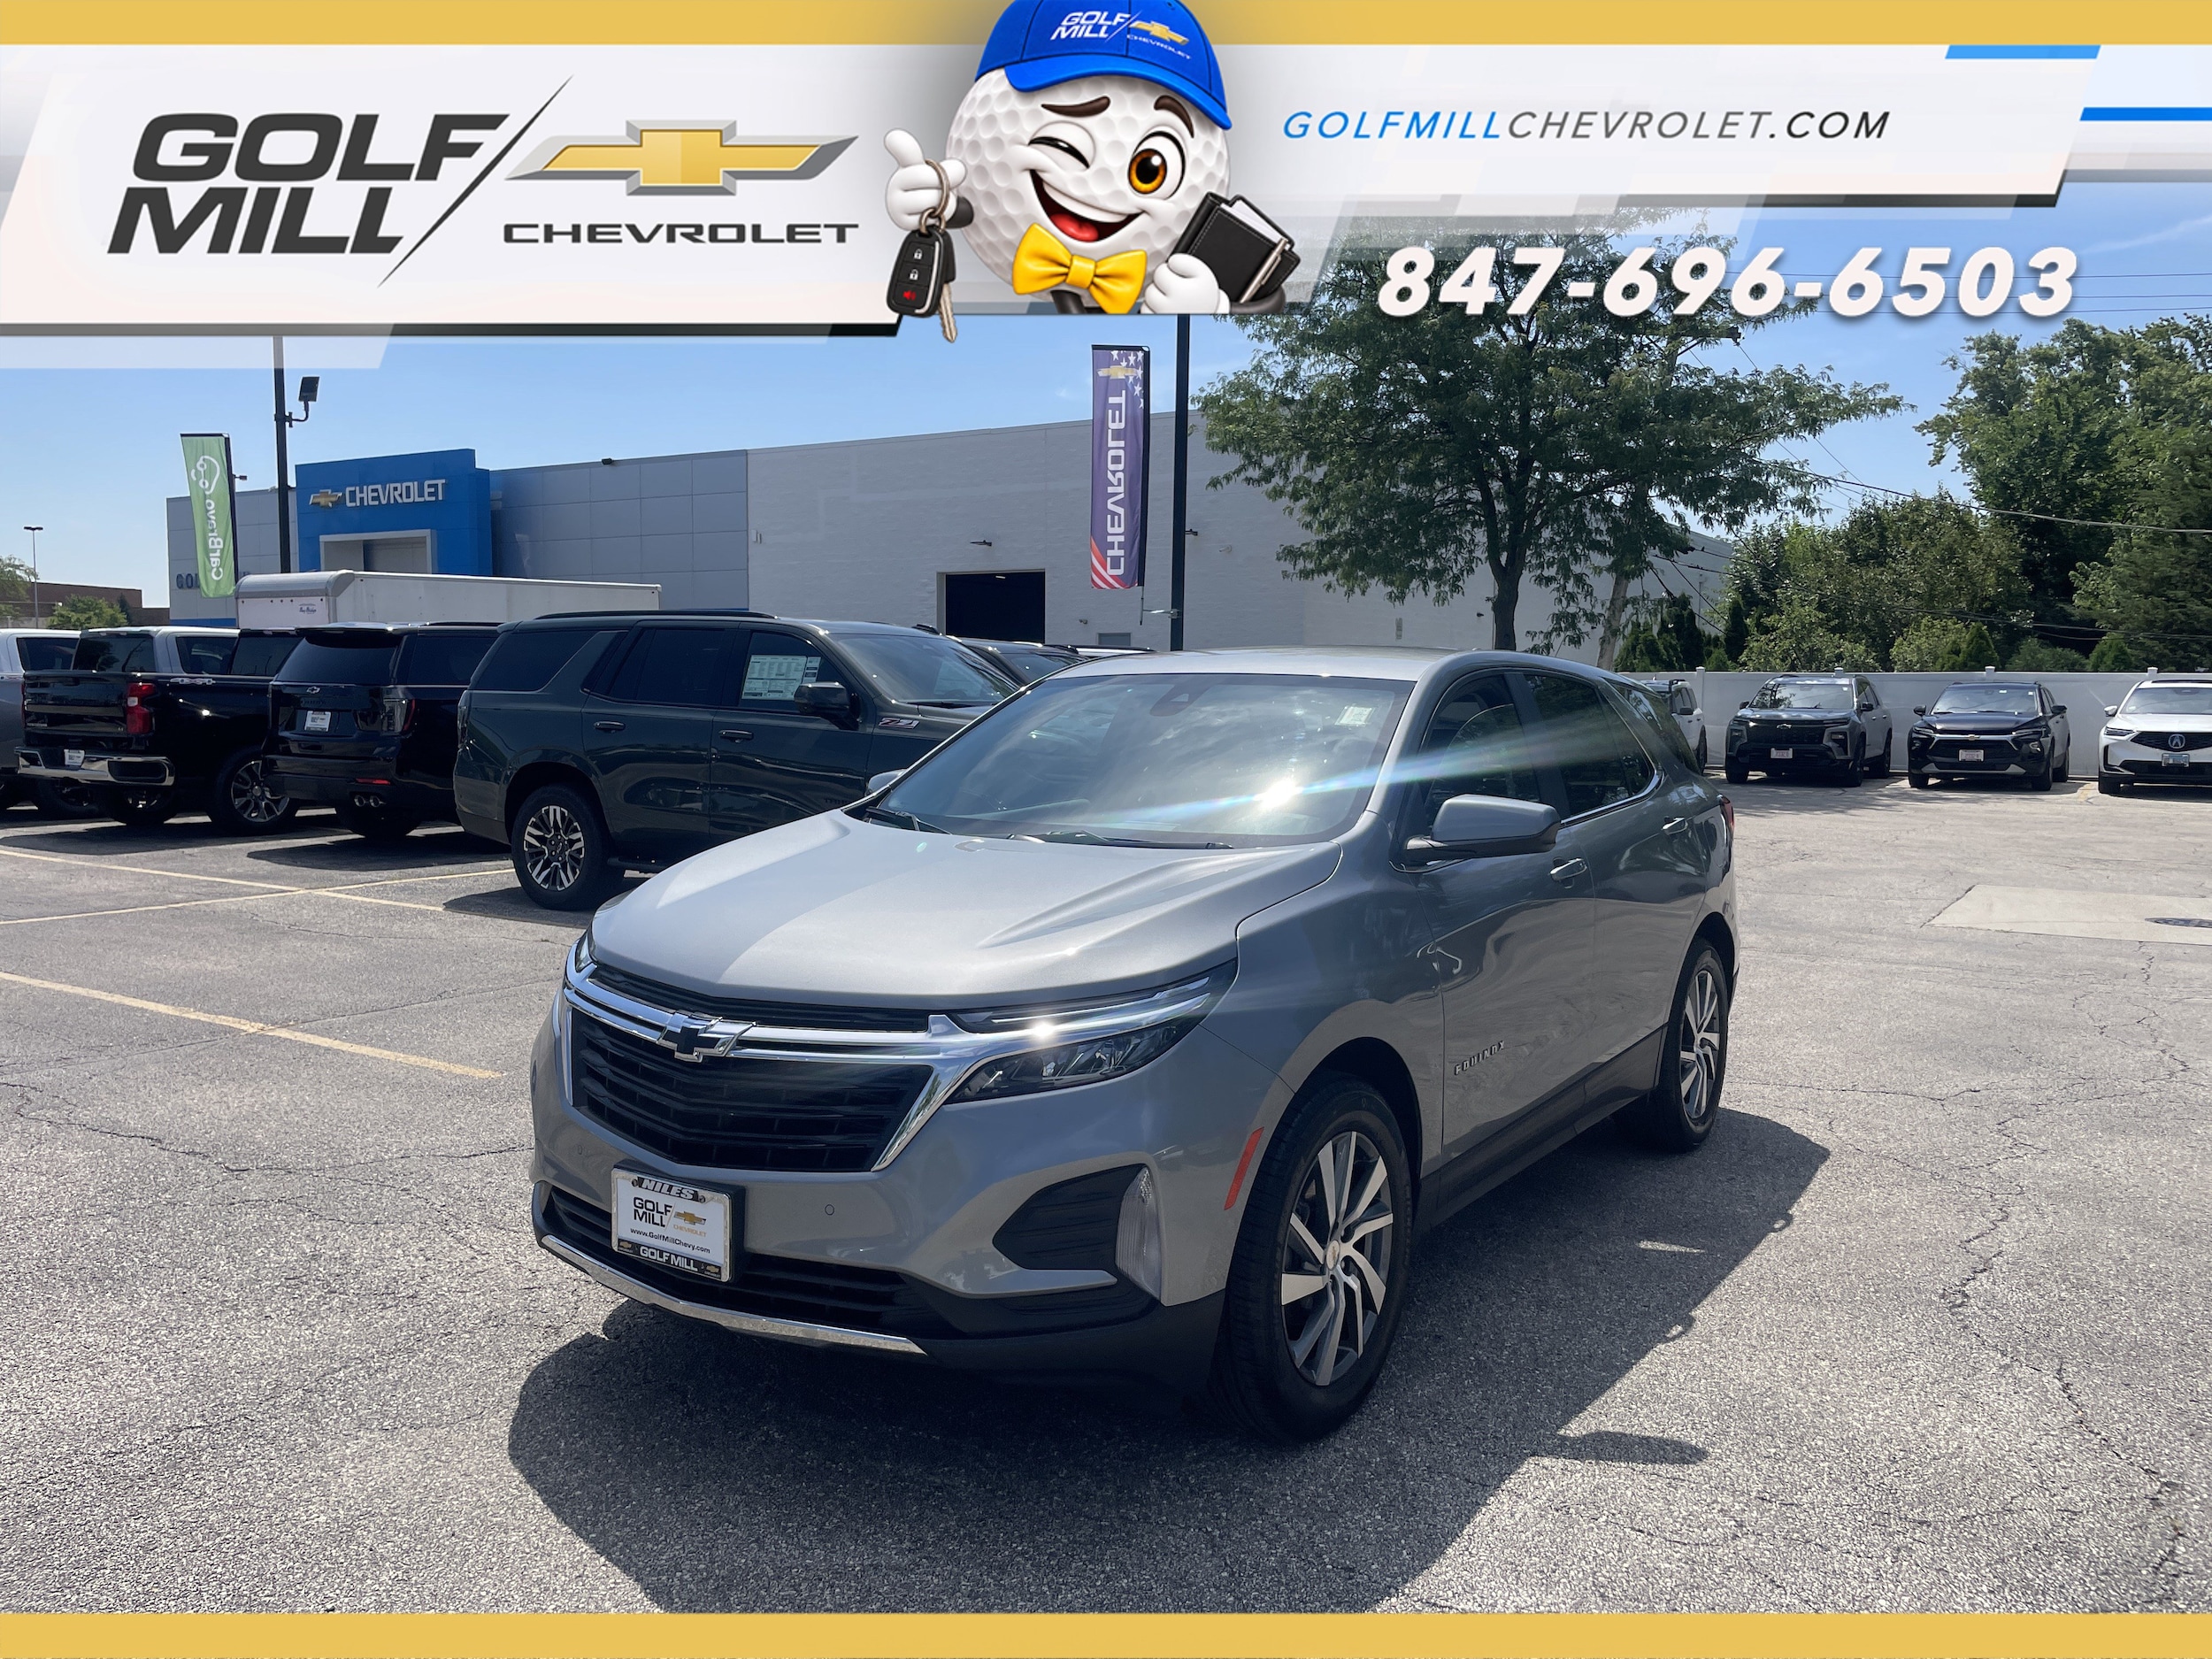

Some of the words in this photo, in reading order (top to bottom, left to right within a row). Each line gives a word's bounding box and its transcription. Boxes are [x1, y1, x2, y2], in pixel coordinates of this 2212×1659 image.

[345, 479, 446, 507] CHEVROLET
[641, 1179, 695, 1201] NILES
[634, 1196, 673, 1217] GOLF
[634, 1209, 665, 1228] MILL
[630, 1227, 710, 1254] www.GolfMillChevy.com
[640, 1246, 670, 1263] GOLF
[671, 1255, 699, 1272] MILL
